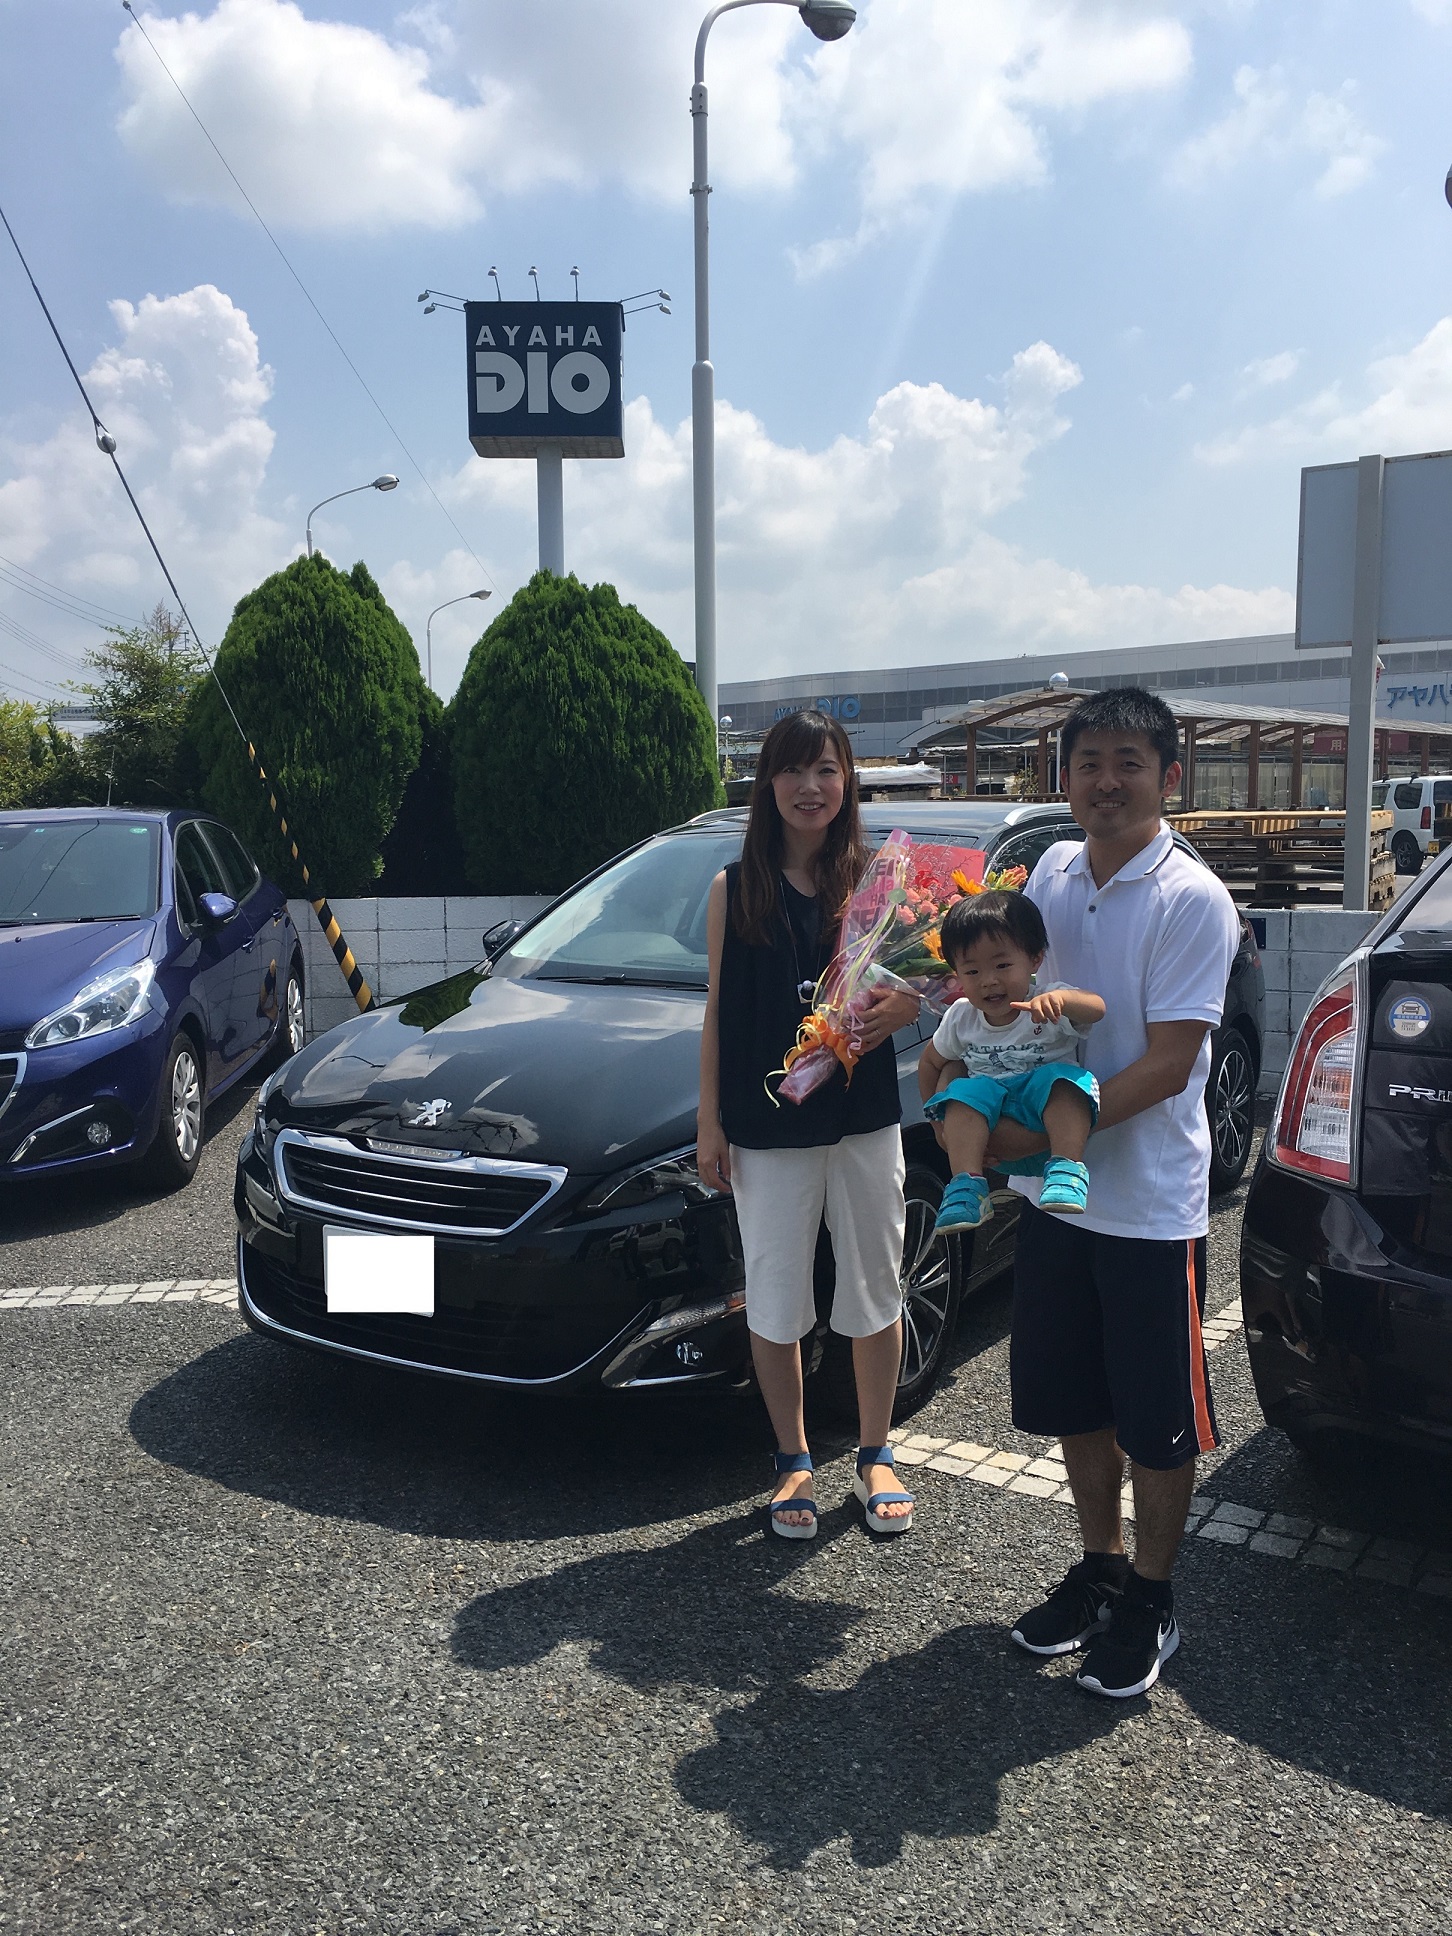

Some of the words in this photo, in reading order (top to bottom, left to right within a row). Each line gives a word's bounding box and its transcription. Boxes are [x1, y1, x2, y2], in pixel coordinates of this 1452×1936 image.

[475, 325, 603, 347] AYAHA
[475, 351, 611, 414] DIO
[1386, 684, 1452, 709] アヤハ
[1388, 1083, 1452, 1103] PRI
